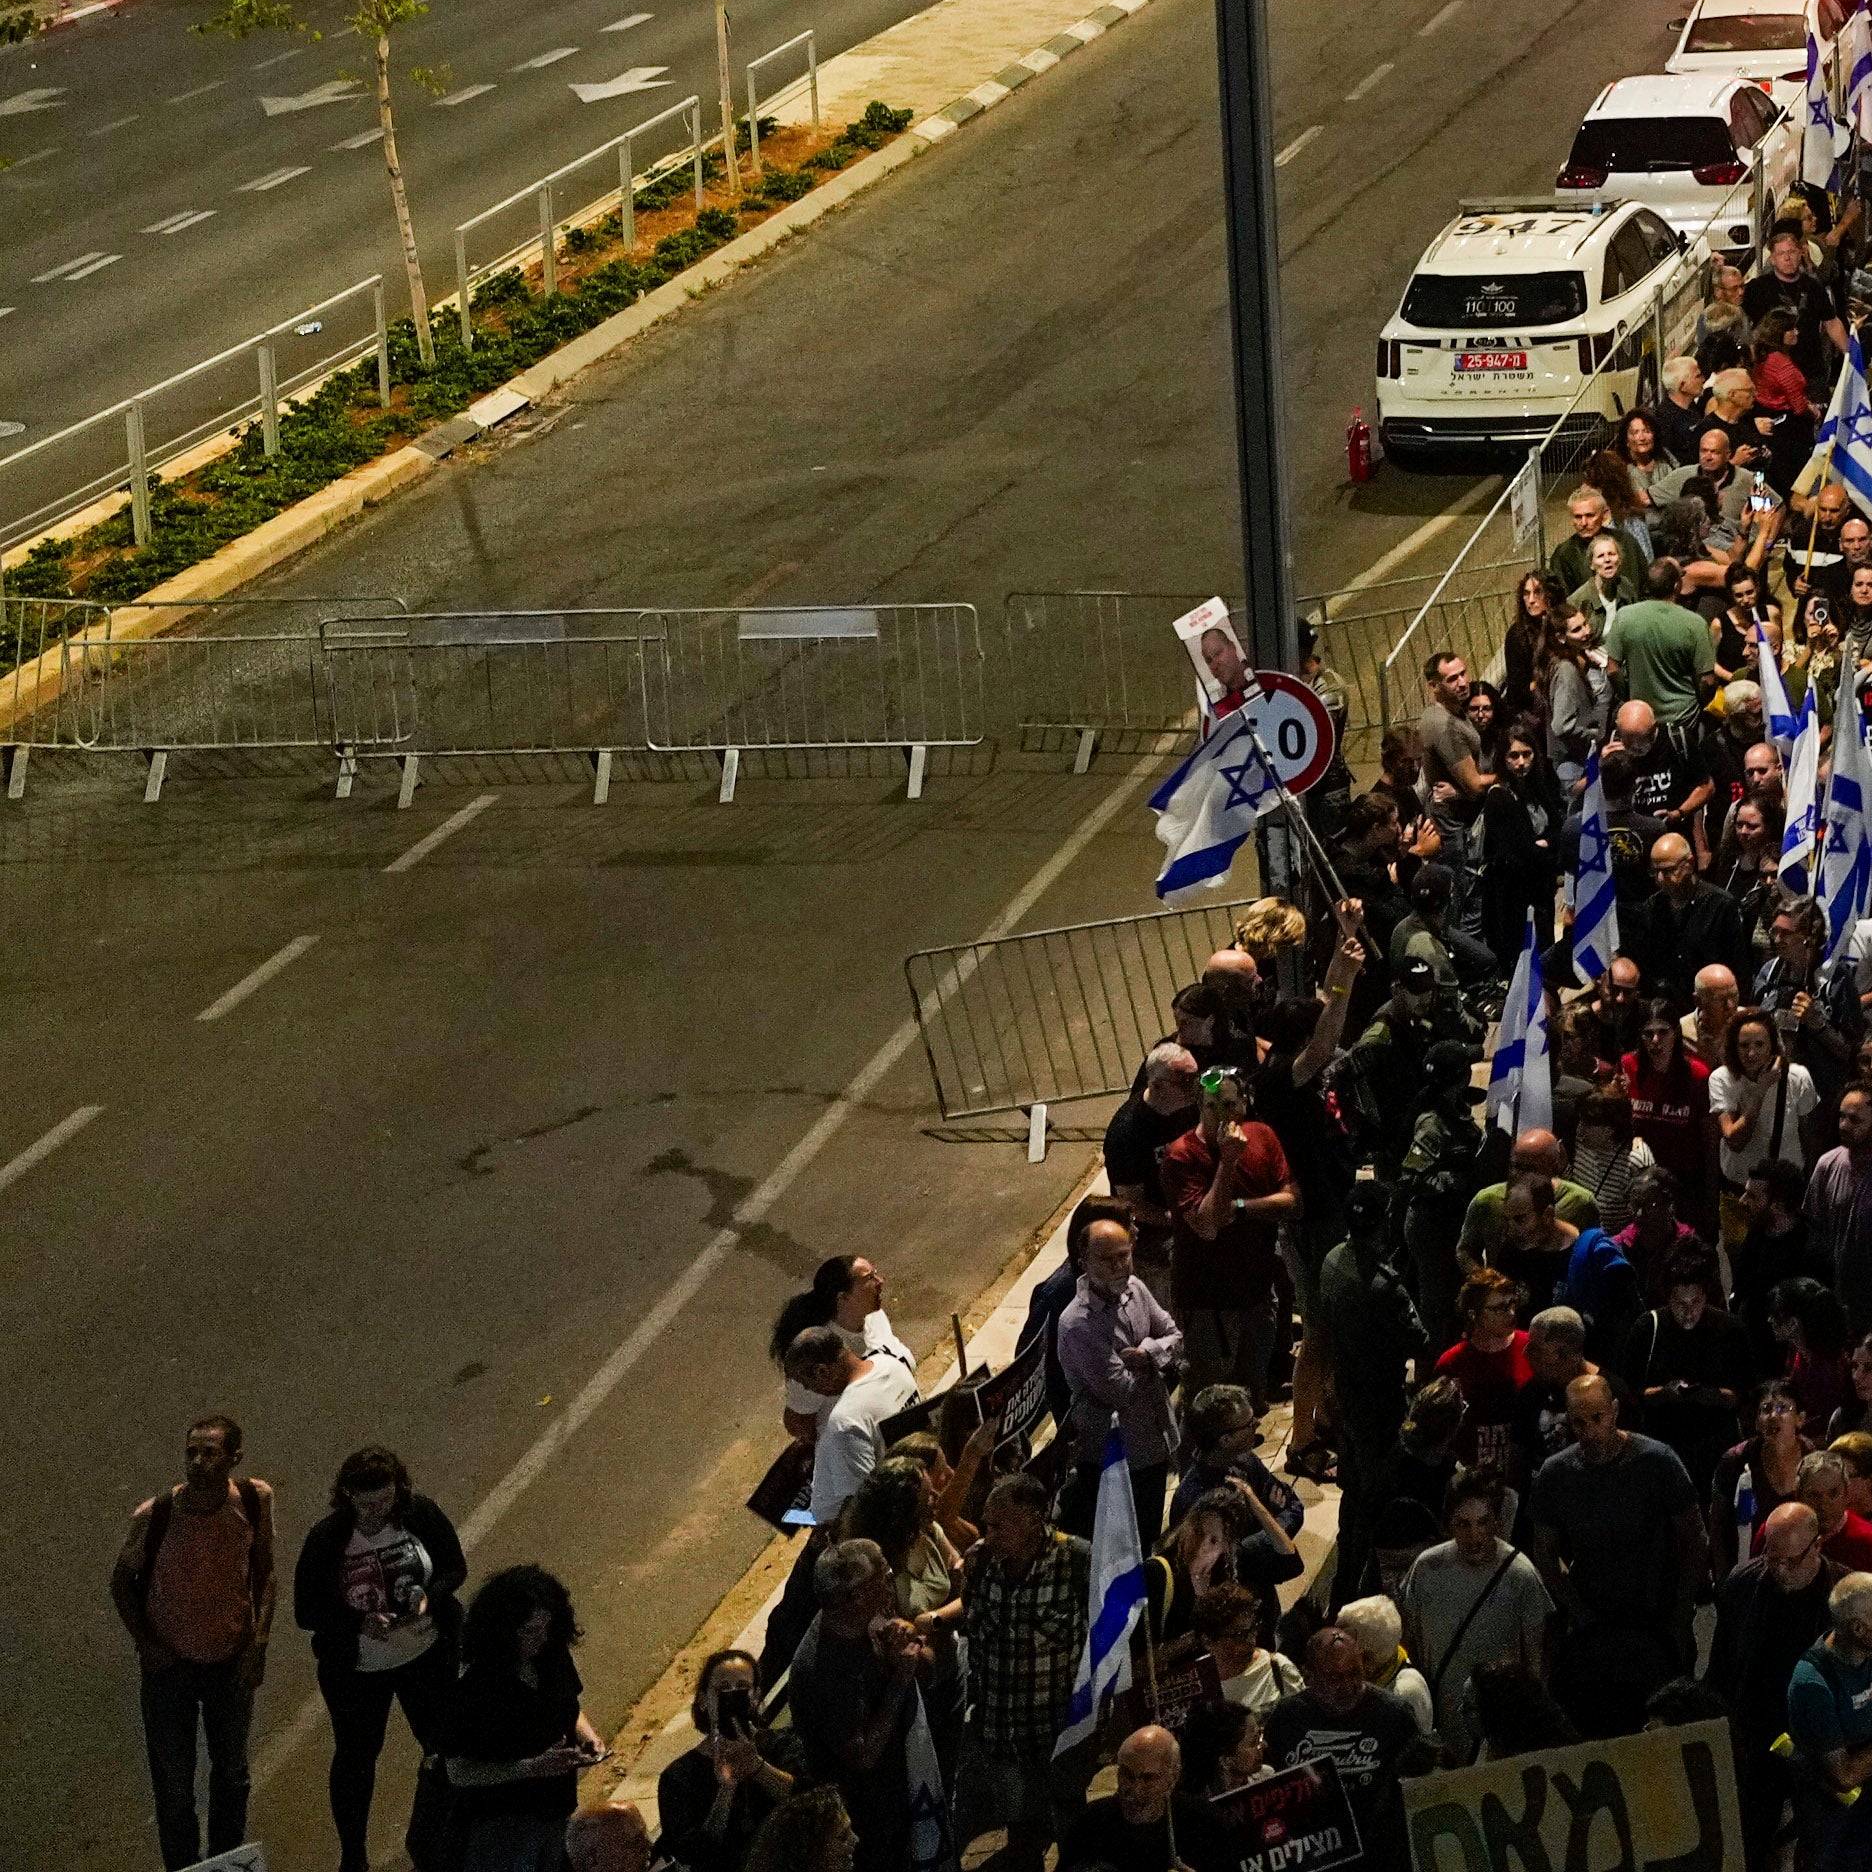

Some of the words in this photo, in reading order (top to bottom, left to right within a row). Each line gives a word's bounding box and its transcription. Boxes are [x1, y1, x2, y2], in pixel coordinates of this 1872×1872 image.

[1452, 216, 1583, 238] 947
[1449, 372, 1487, 383] ישראל
[1492, 371, 1534, 383] משטרת
